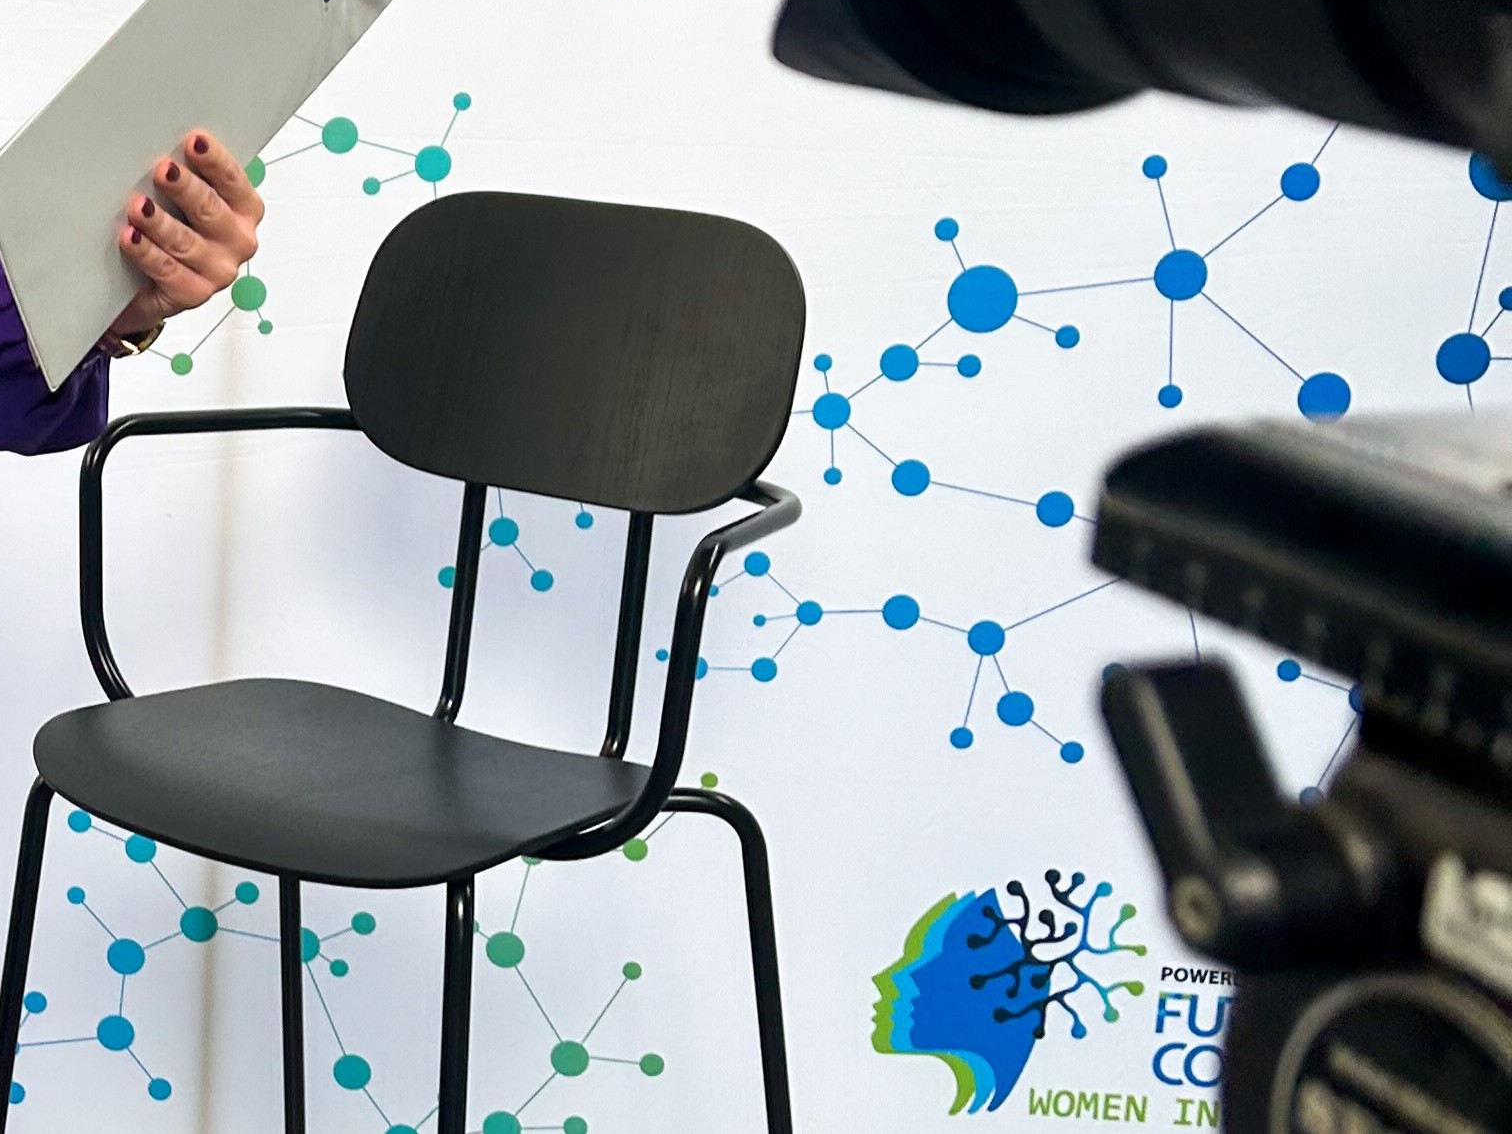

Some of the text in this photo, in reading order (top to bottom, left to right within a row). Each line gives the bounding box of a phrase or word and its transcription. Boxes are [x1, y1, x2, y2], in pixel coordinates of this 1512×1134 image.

[1160, 966, 1236, 986] POWER
[1028, 1088, 1222, 1128] WOMEN IN
